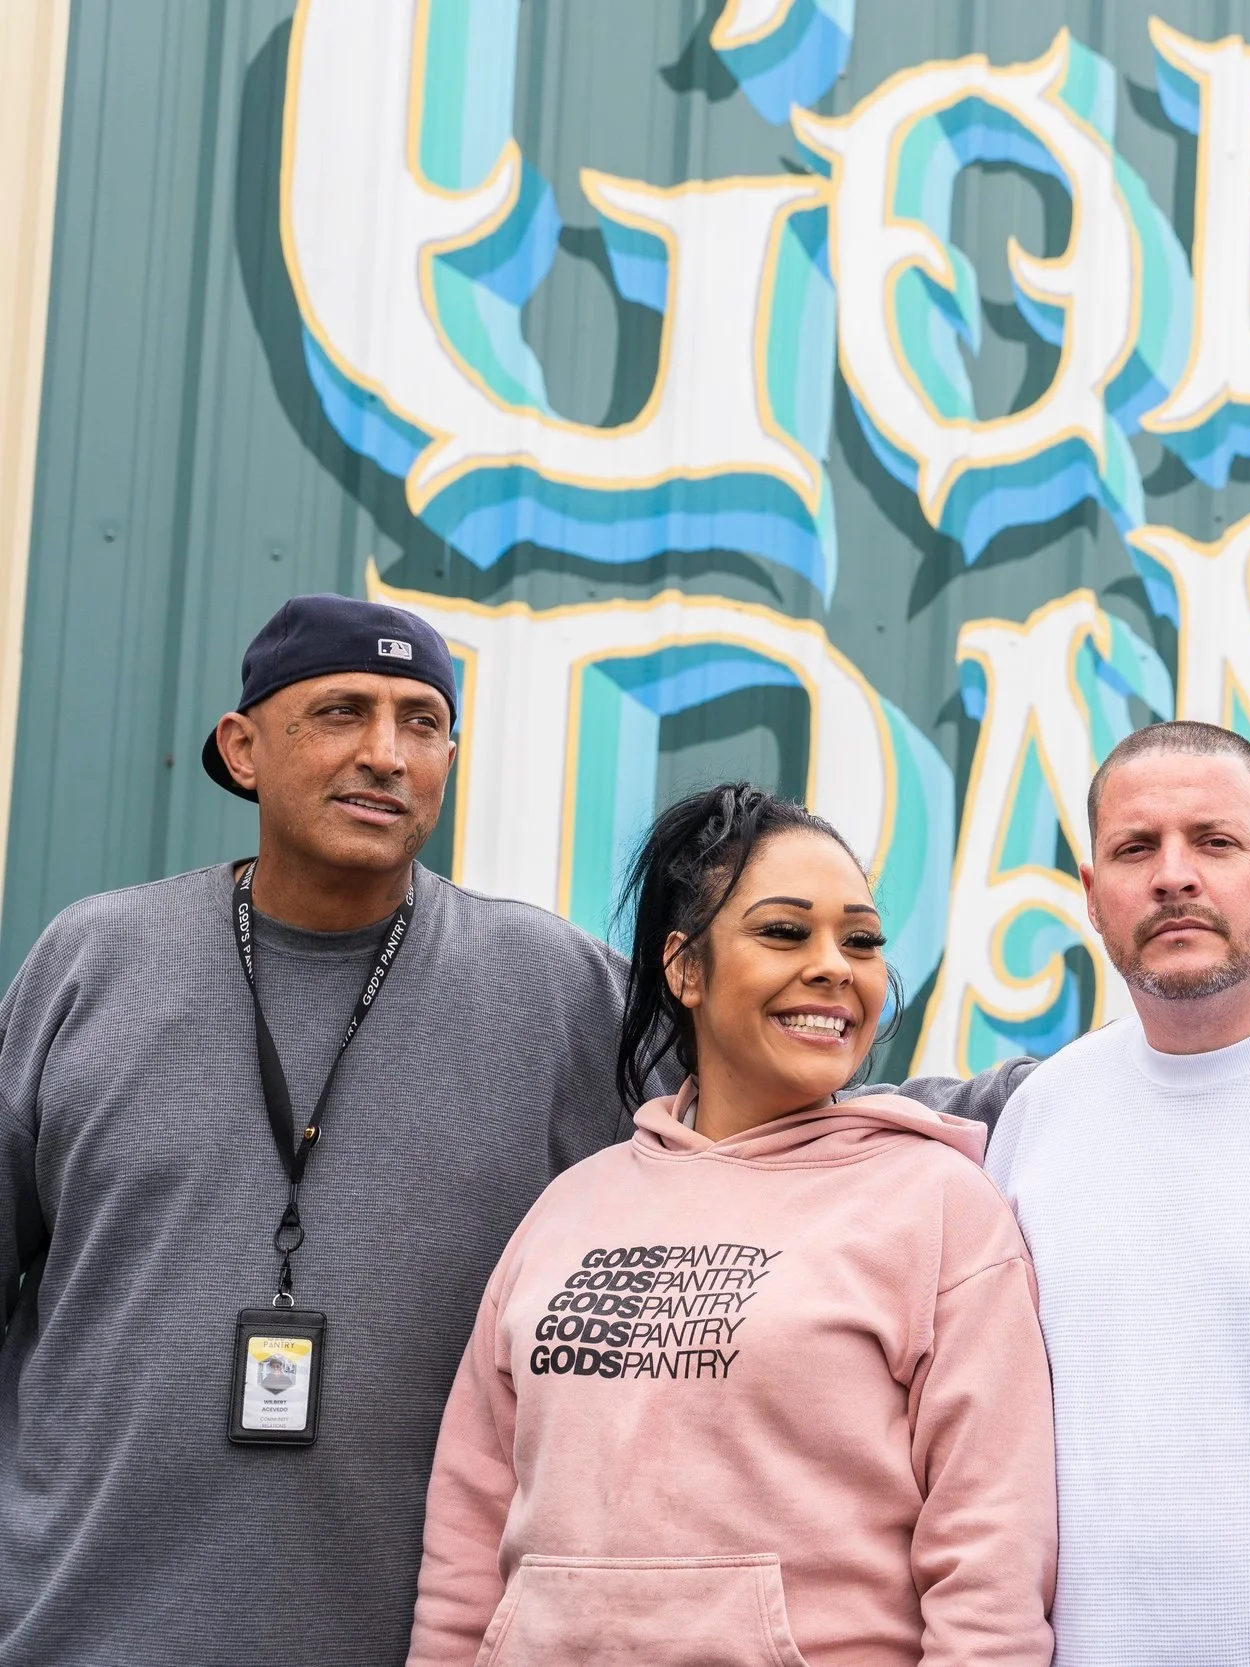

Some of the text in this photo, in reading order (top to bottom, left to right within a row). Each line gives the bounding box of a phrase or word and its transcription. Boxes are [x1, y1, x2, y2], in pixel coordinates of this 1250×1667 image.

[380, 914, 407, 966] PANTRY
[581, 1243, 784, 1269] GODSPANTRY
[564, 1268, 770, 1294] GODSPANTRY
[547, 1291, 758, 1320] GODSPANTRY
[263, 1340, 295, 1349] PANTRY
[535, 1314, 746, 1348] GODSPANTRY
[530, 1344, 740, 1379] GODSPANTRY
